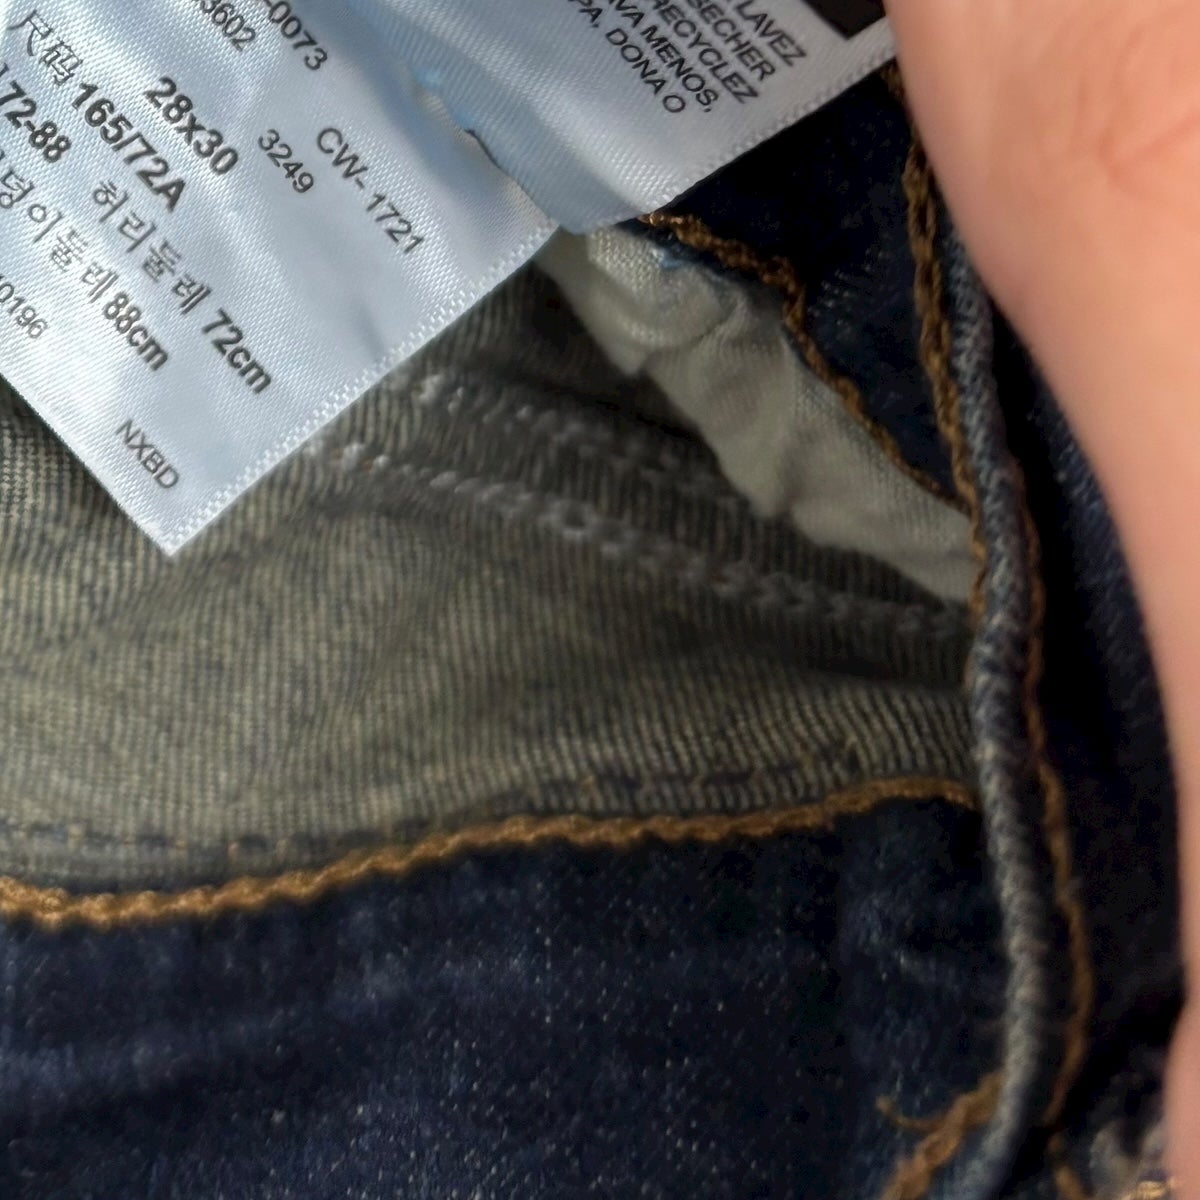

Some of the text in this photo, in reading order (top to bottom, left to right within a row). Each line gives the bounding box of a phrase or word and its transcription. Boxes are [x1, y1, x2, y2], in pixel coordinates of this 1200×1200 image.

[605, 27, 667, 95] DONA
[662, 94, 686, 114] O
[640, 24, 719, 112] MENOS,
[734, 0, 807, 67] LAVEZ
[143, 76, 239, 176] 28x30
[258, 129, 314, 194] 3249
[201, 307, 272, 394] 72cm
[115, 418, 180, 489] NXBD
